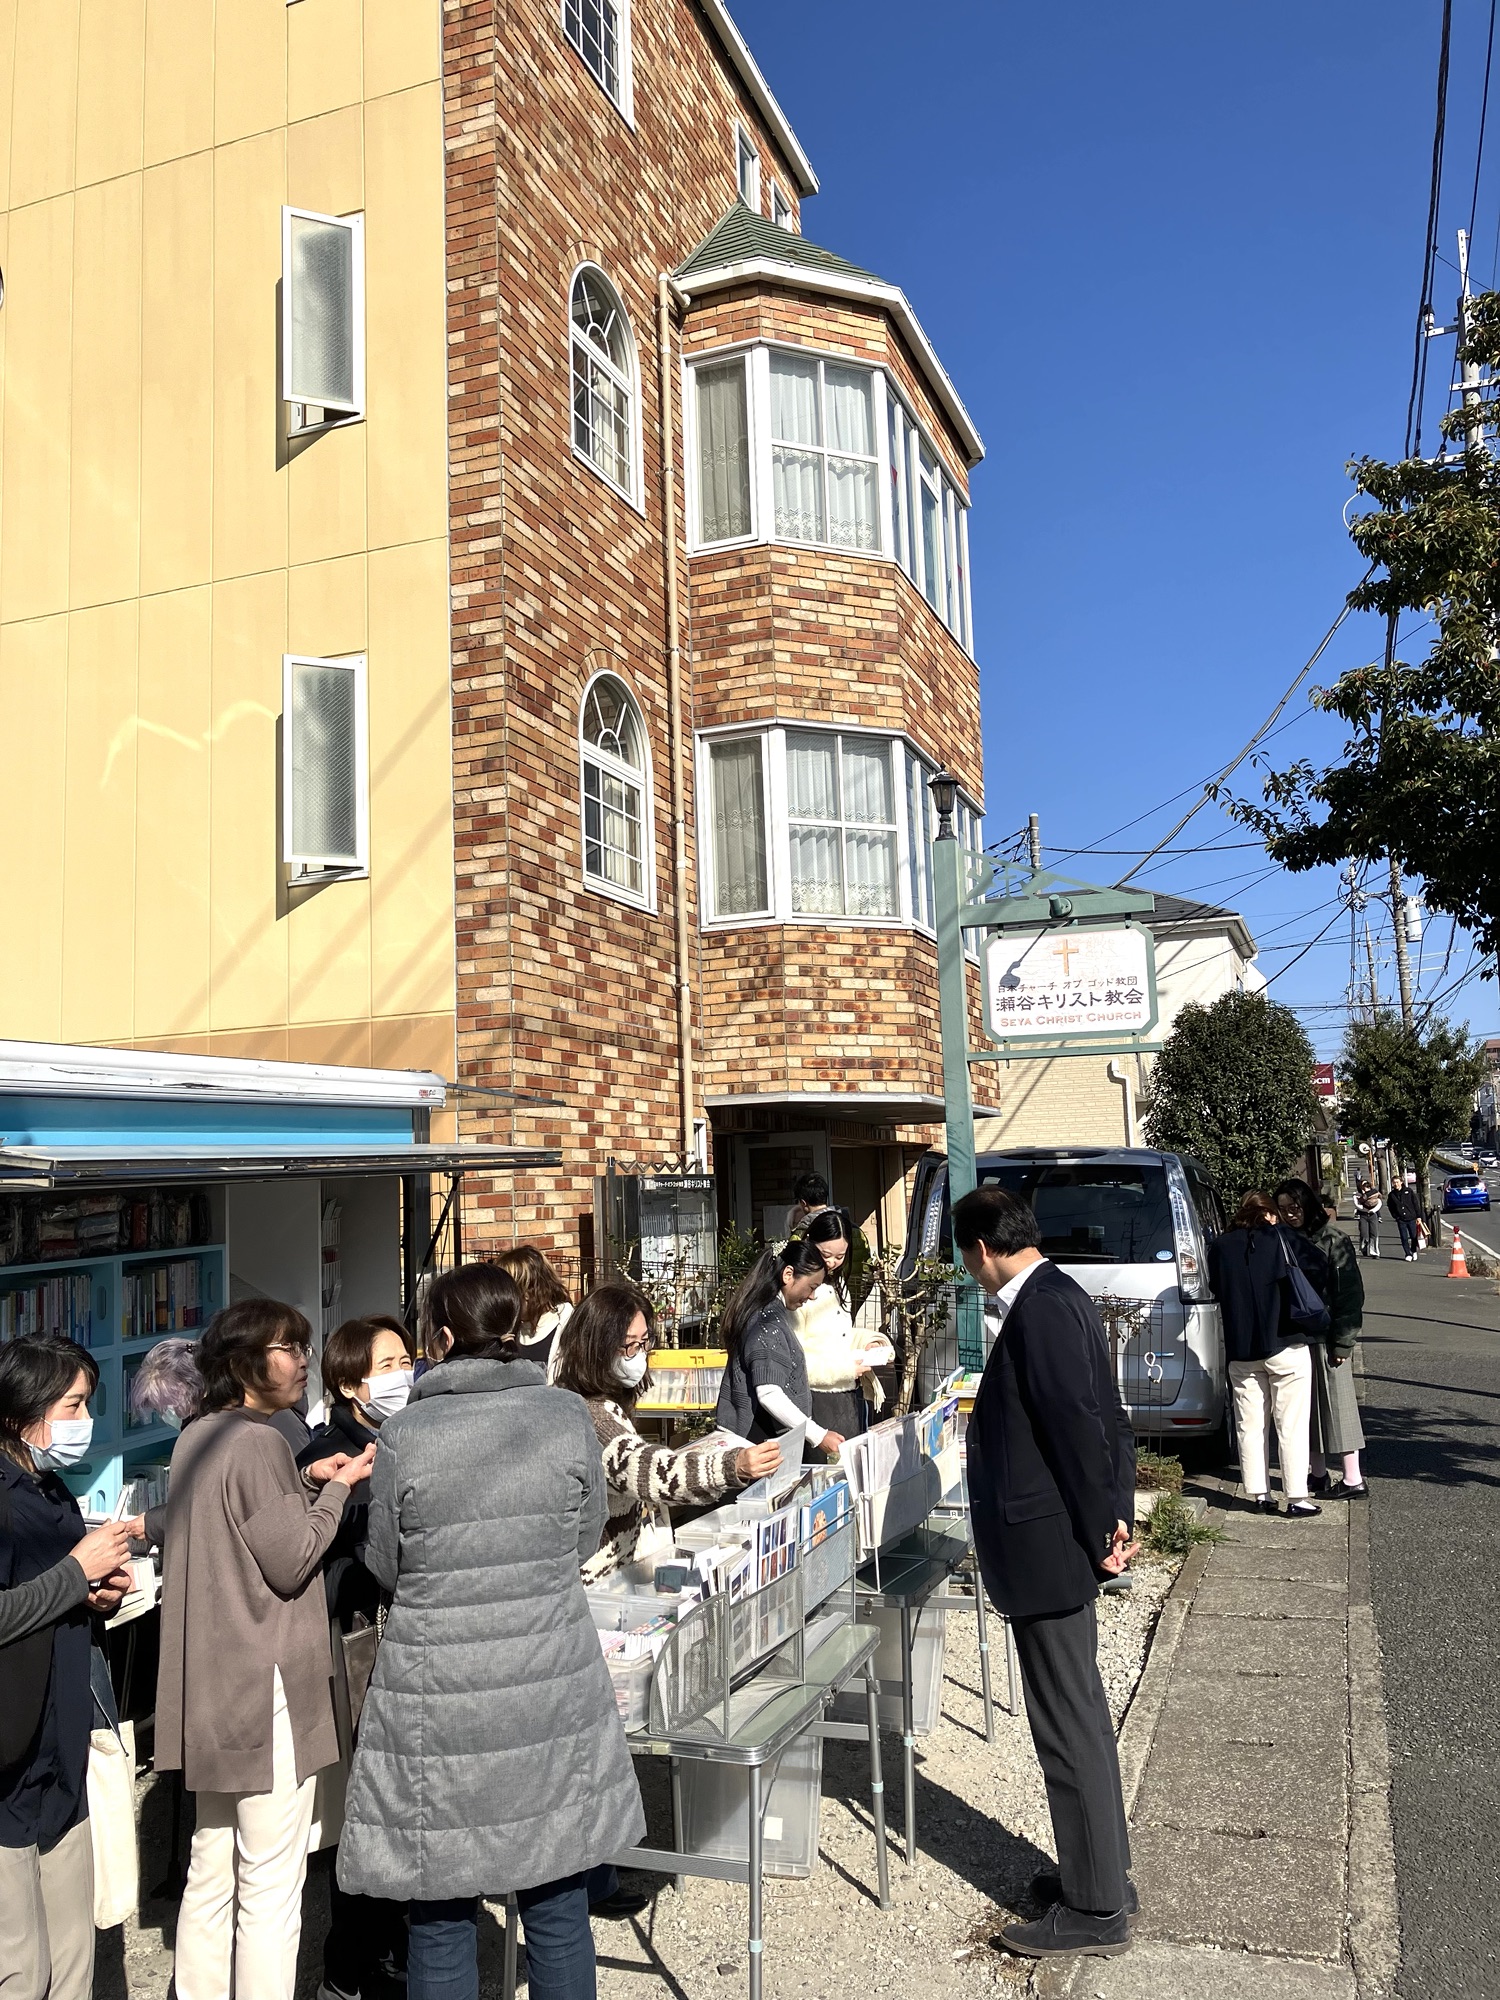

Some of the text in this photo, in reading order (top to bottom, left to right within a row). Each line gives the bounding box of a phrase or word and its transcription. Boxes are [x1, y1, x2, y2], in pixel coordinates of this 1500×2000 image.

[996, 988, 1144, 1012] 瀬谷キリスト教会
